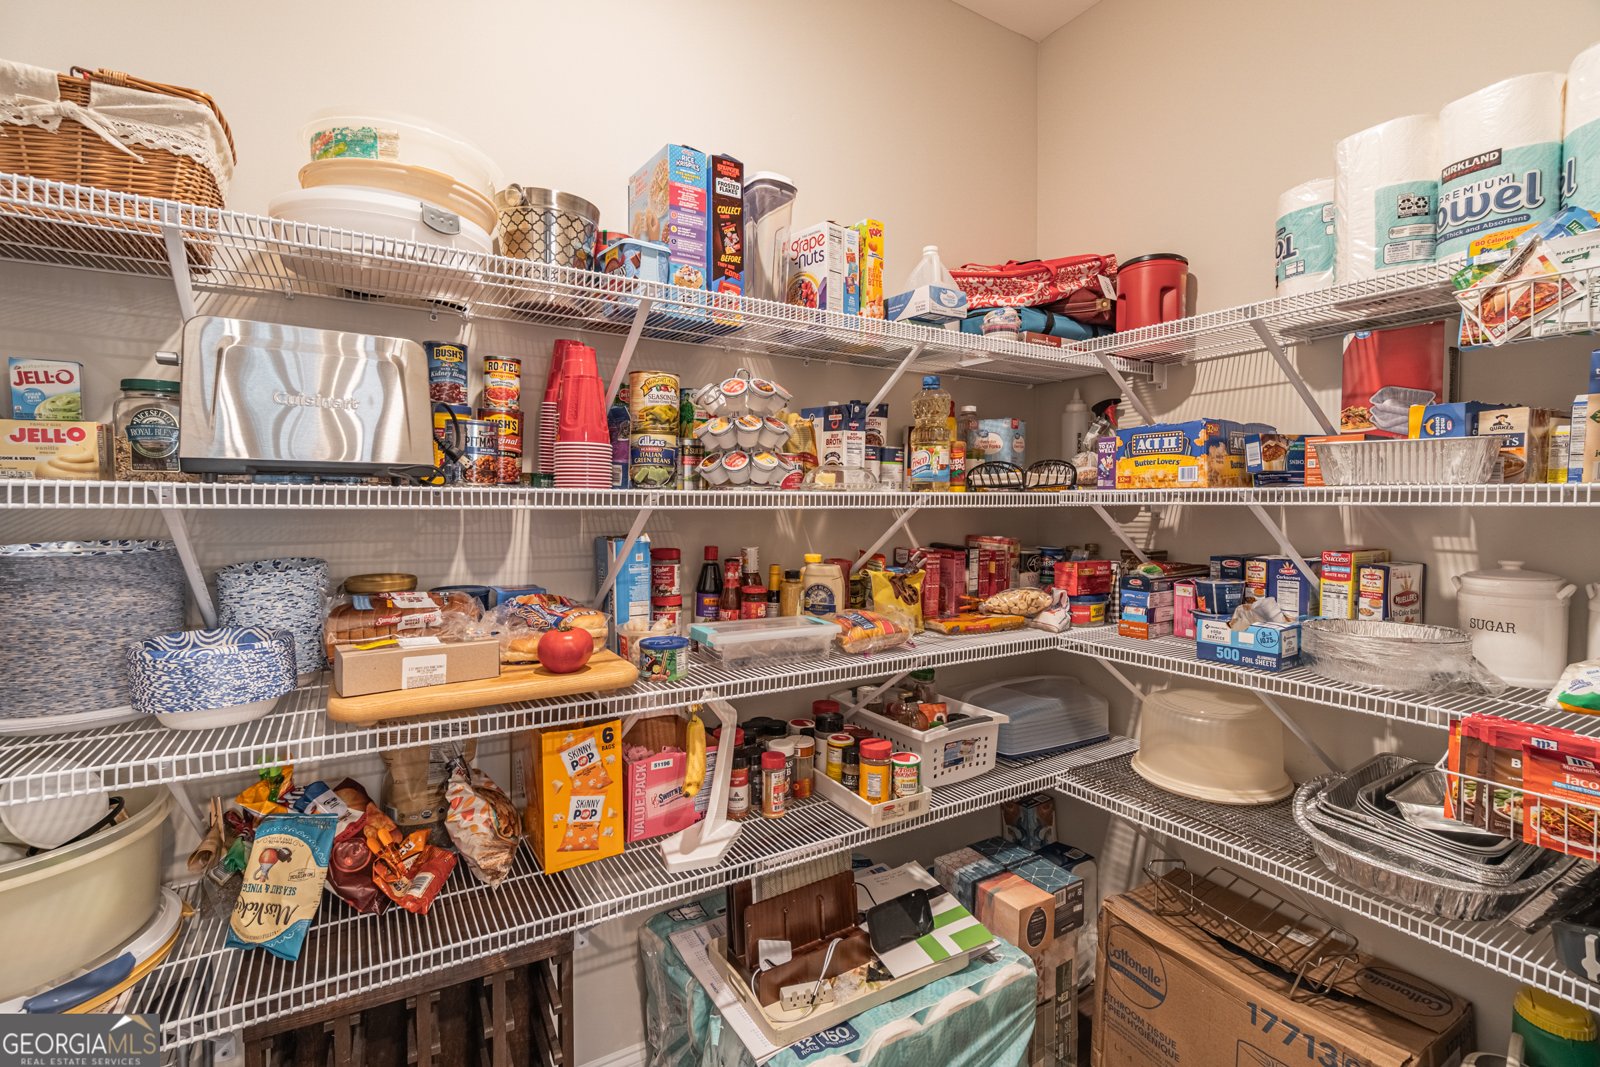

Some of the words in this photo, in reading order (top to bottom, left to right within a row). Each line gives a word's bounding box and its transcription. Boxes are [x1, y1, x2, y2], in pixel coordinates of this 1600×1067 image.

[681, 154, 695, 163] RICE
[1442, 151, 1499, 178] KIRKLAND
[717, 181, 740, 191] FROSTED
[719, 186, 738, 196] FLAKES
[1439, 175, 1511, 204] PREMIUM
[1437, 170, 1540, 231] owel
[717, 205, 741, 216] COLLECT
[1446, 229, 1463, 240] Thick
[1465, 224, 1480, 234] and
[1483, 214, 1528, 229] Absorbent
[791, 233, 825, 262] grape
[1487, 234, 1514, 245] Calories
[720, 254, 741, 264] BEFORE
[435, 348, 463, 360] BUSH'S
[13, 369, 75, 386] JELL-O
[272, 391, 361, 410] Cuisinart
[9, 427, 86, 443] JELL-O
[130, 427, 154, 436] ROYAL
[1137, 438, 1161, 450] ACT
[1162, 436, 1178, 449] II
[1135, 458, 1156, 467] Butter
[1157, 457, 1180, 466] Lovers
[1324, 554, 1349, 563] Success
[1469, 617, 1516, 634] SUGAR
[1216, 646, 1240, 661] 500
[1241, 656, 1254, 664] FOIL
[1255, 658, 1277, 668] SHEETS
[601, 727, 614, 743] 6
[601, 743, 615, 751] BAGS
[571, 752, 595, 772] POP
[633, 764, 647, 793] PACK
[1562, 773, 1600, 790] Taco
[573, 808, 597, 821] POP
[633, 797, 647, 837] VALUE
[283, 886, 297, 896] SEA
[264, 902, 300, 926] Miss
[1109, 942, 1162, 987] Cottonelle
[818, 1026, 850, 1042] 160
[1147, 1021, 1177, 1050] TISSUE
[800, 1046, 819, 1056] ROLLS
